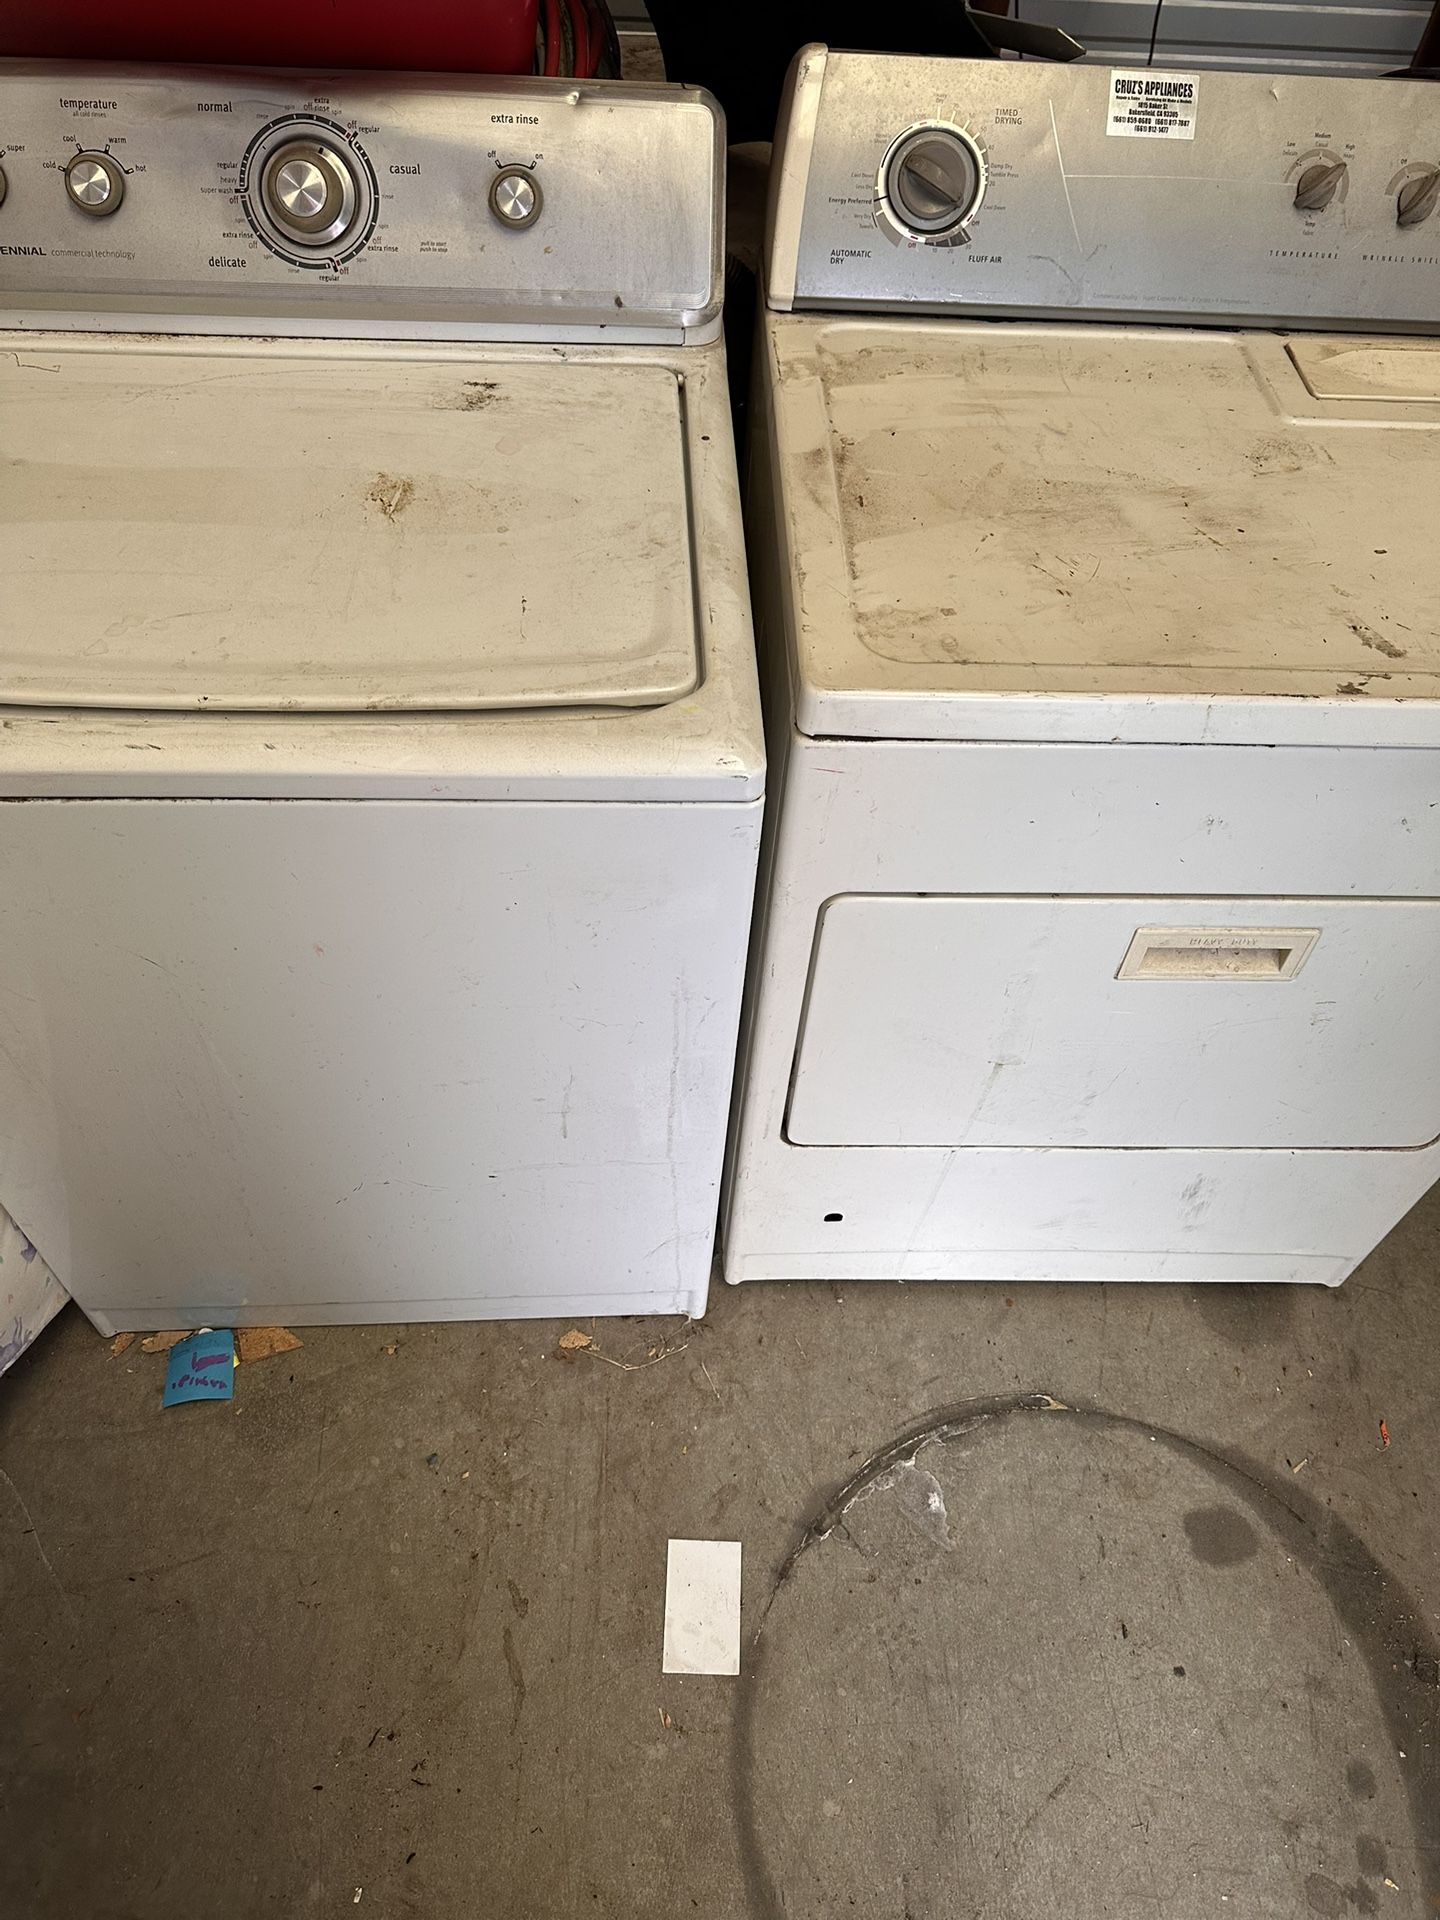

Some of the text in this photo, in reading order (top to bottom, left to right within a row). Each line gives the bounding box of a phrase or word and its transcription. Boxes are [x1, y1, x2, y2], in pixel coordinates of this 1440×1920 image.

[1115, 79, 1193, 98] CRUZ'S APPLIANCES
[60, 98, 118, 111] temperature
[197, 101, 232, 113] normal
[995, 108, 1018, 117] TIMED
[491, 114, 539, 125] extra rinse
[995, 117, 1022, 125] DRYING
[347, 120, 357, 130] off
[358, 125, 380, 134] regular
[62, 134, 77, 143] cool
[109, 136, 127, 144] warm
[6, 143, 25, 152] super
[487, 150, 496, 158] off
[42, 161, 57, 169] cold
[136, 164, 146, 172] hot
[216, 161, 238, 170] regular
[389, 163, 421, 175] casual
[229, 196, 239, 205] off
[829, 197, 846, 205] Energy
[0, 246, 136, 261] ENNIAL commercial technology
[831, 249, 872, 259] AUTOMATIC
[1269, 250, 1339, 260] TEMPERATURE
[208, 257, 247, 268] delicate
[830, 257, 845, 265] DRY
[968, 255, 987, 263] FLUFF
[1362, 254, 1404, 263] WRINKLE
[339, 267, 349, 275] off
[319, 275, 340, 283] regular
